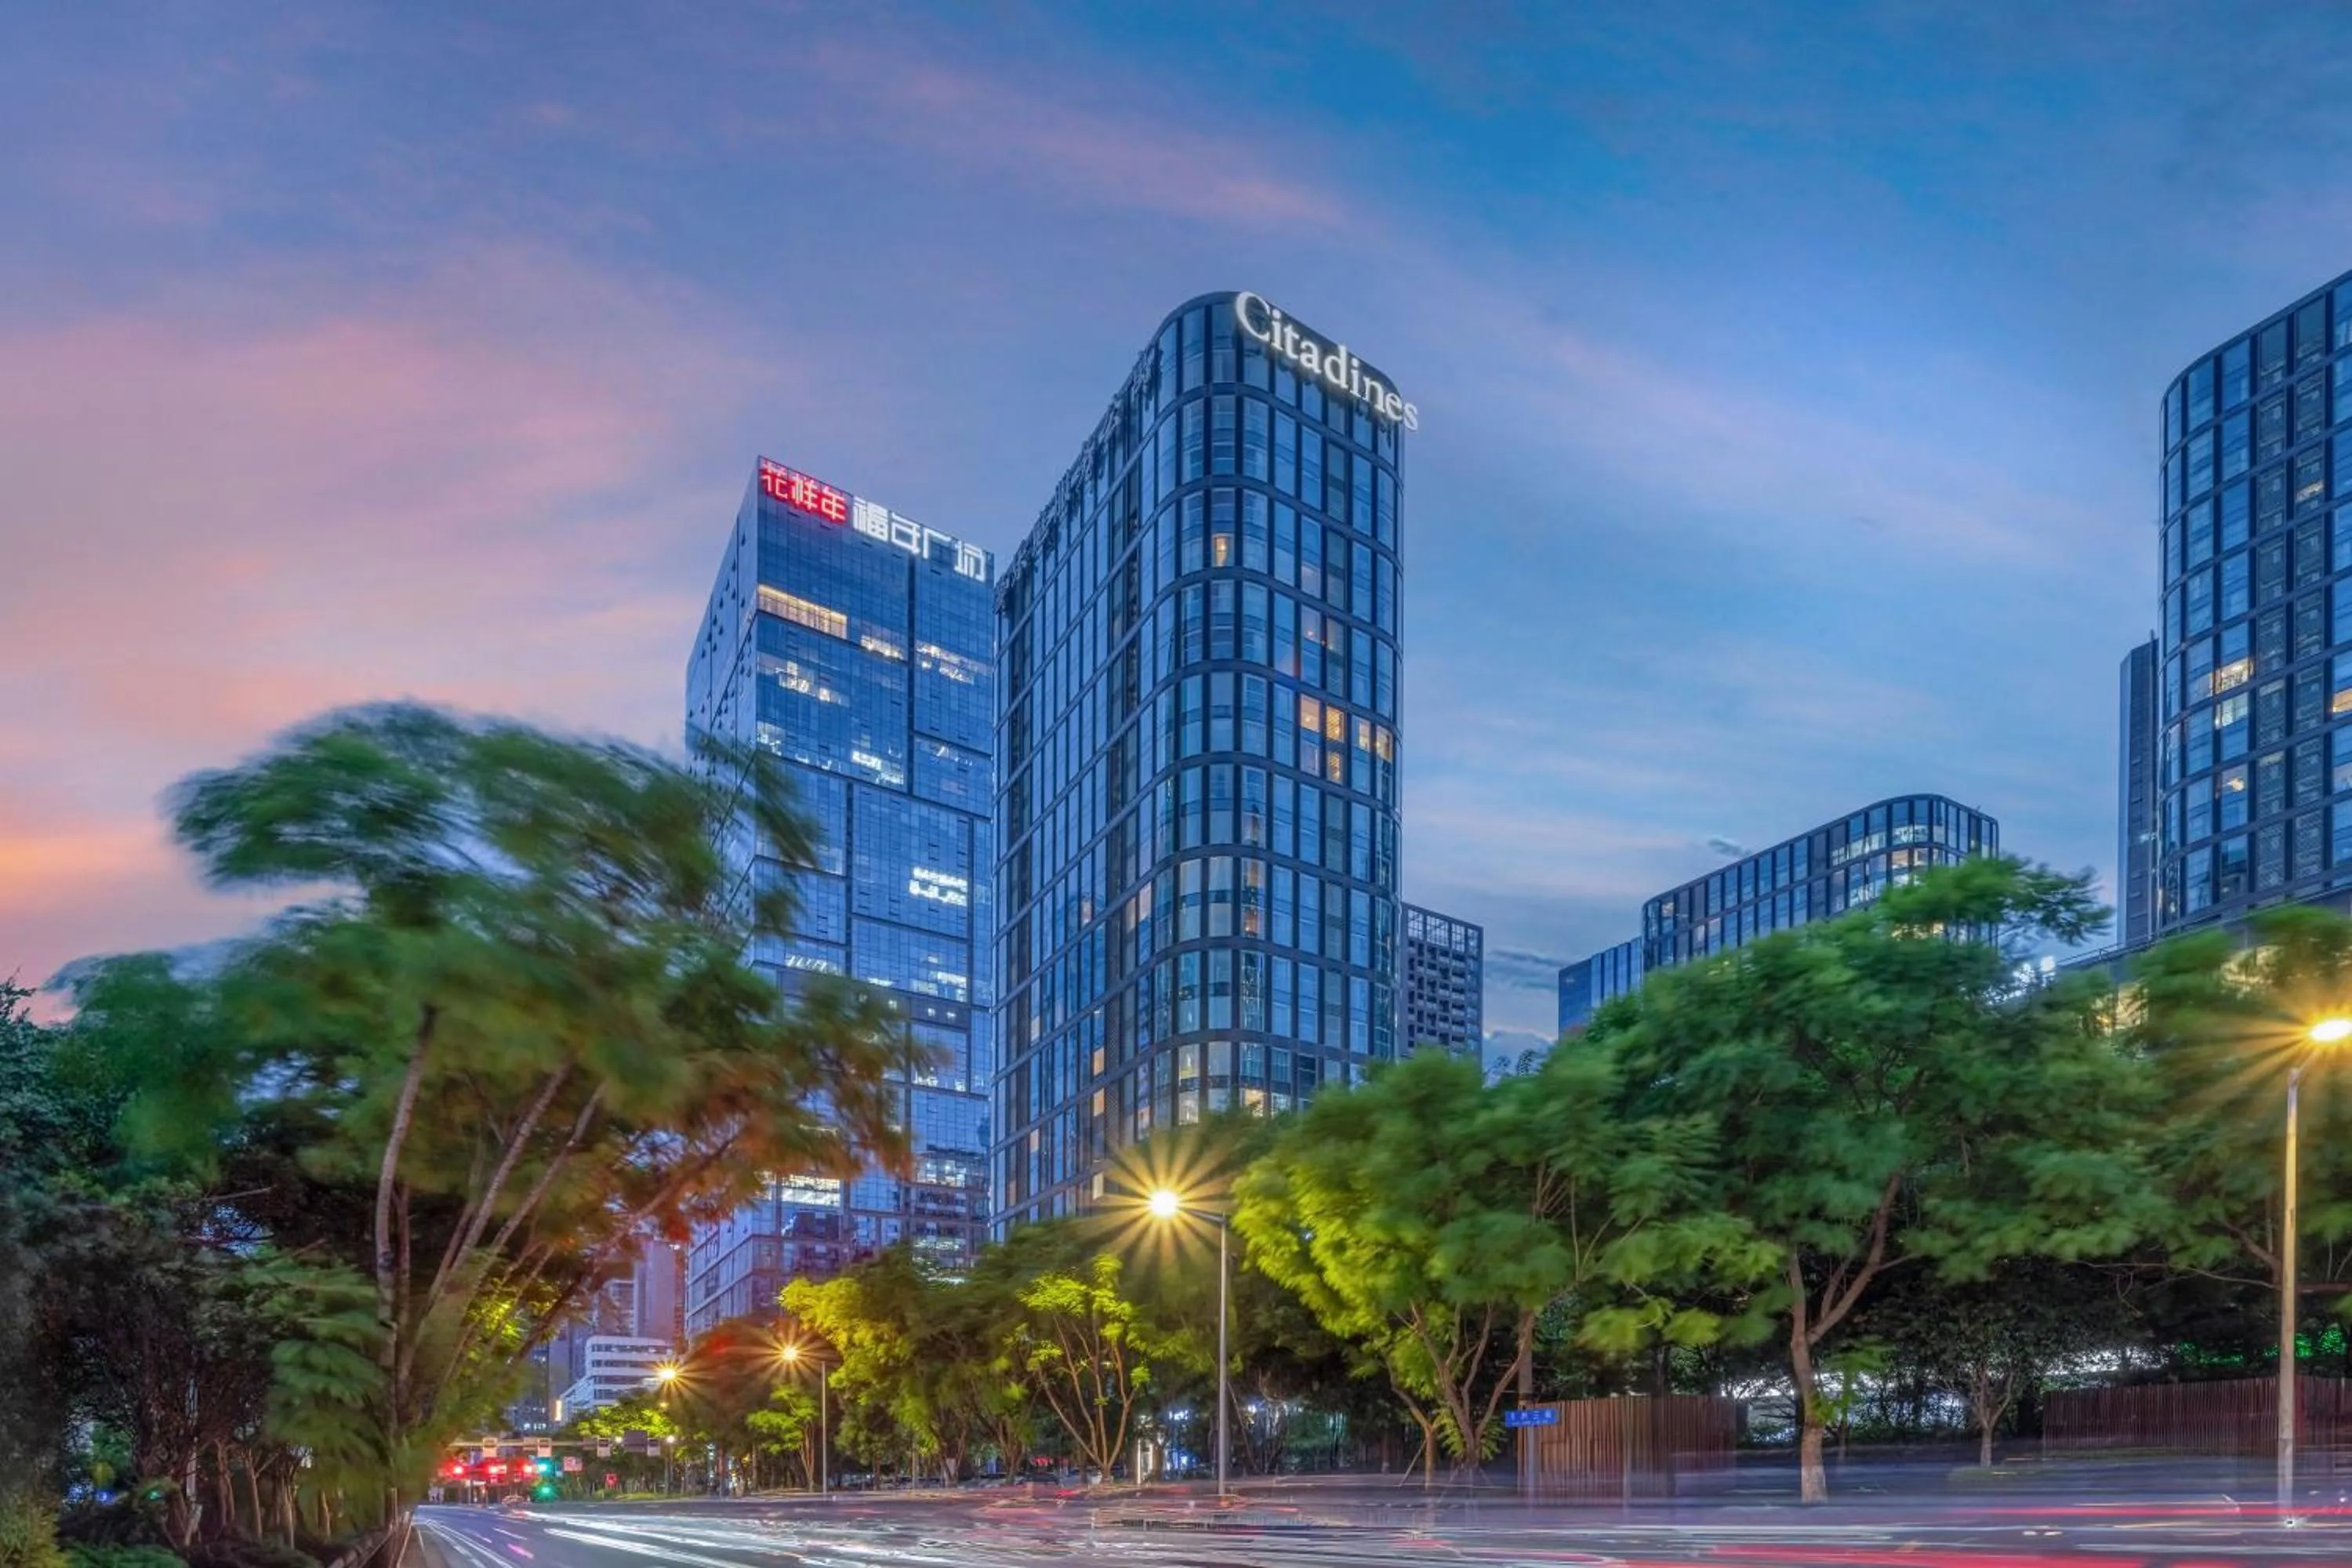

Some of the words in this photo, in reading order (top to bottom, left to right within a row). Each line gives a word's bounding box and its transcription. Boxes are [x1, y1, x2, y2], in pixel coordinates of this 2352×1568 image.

[1236, 291, 1418, 432] Citadines
[760, 459, 847, 521] 花样年
